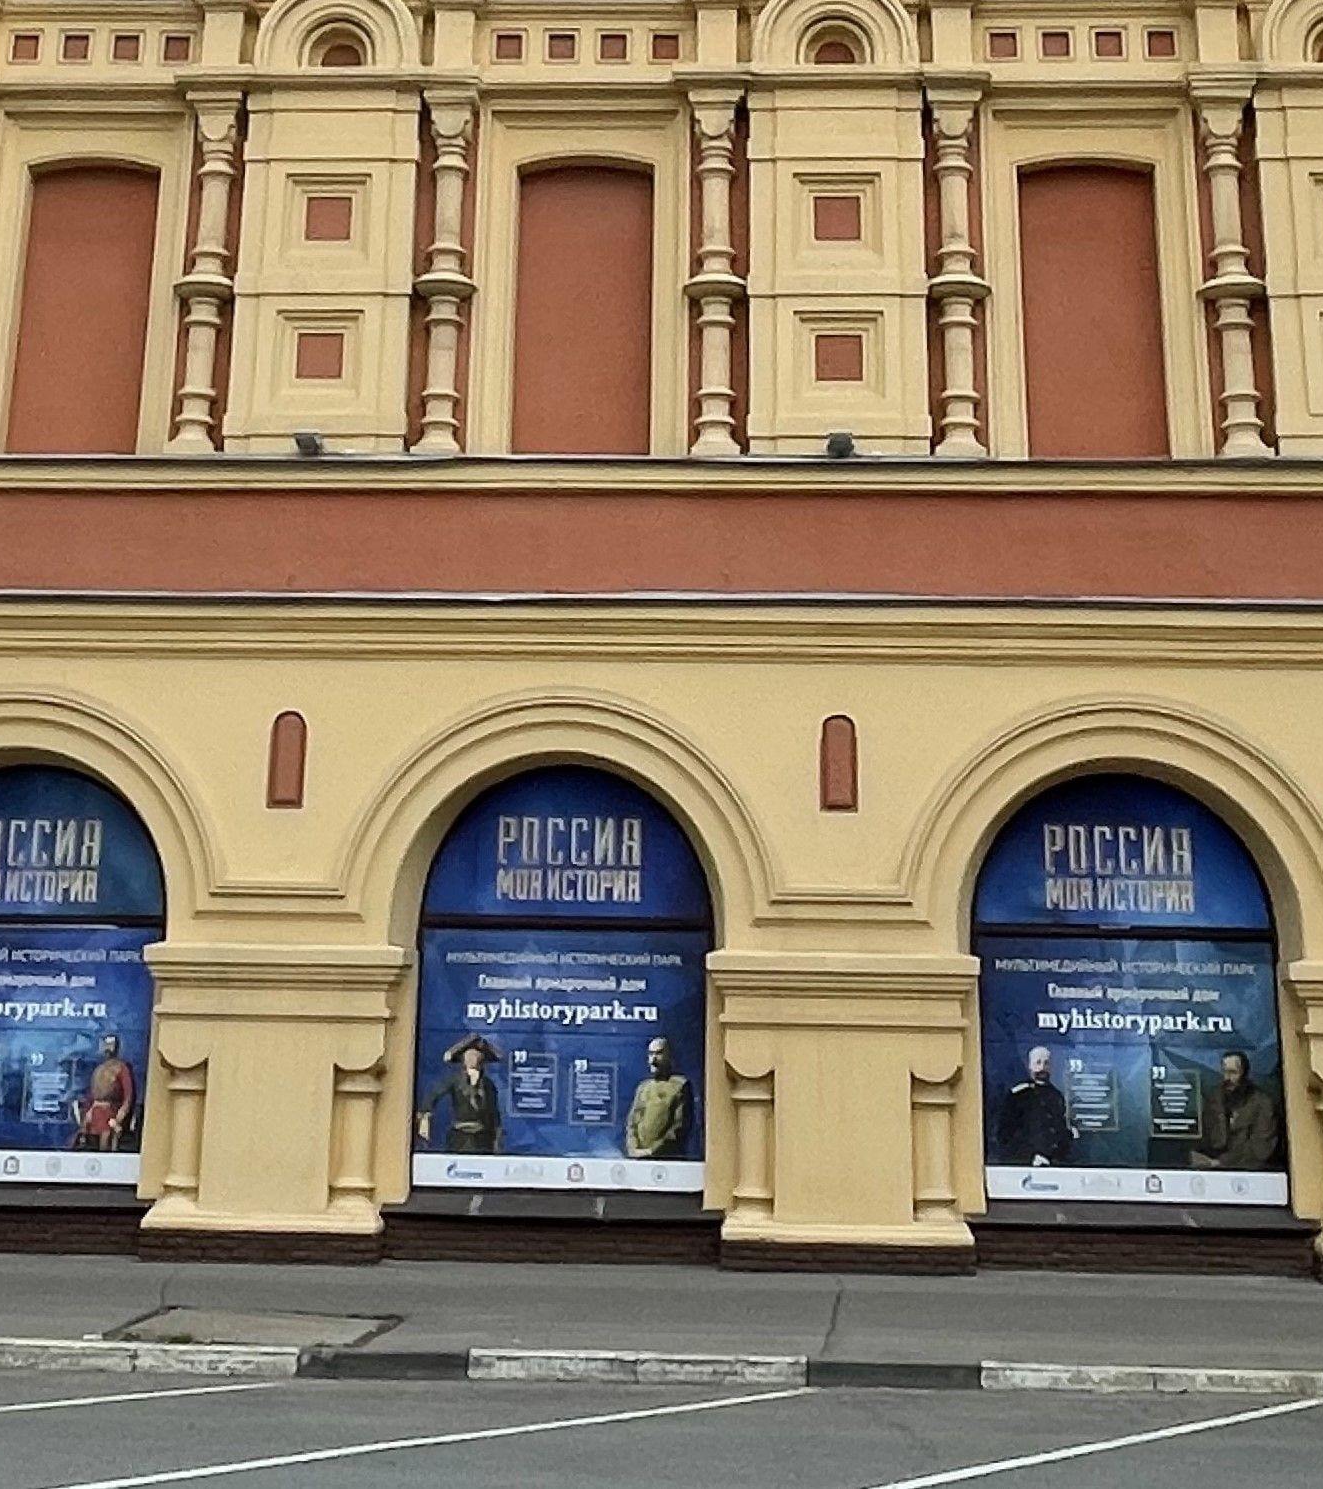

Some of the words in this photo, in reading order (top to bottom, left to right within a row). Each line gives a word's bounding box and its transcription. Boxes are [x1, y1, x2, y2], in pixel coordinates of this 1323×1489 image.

[498, 815, 643, 867] РОССИЯ
[1043, 823, 1192, 876] РОССИЯ
[4, 870, 98, 904] ИСТОРИЯ
[496, 868, 543, 901] МОЯ
[546, 868, 642, 903] ИСТОРИЯ
[1046, 877, 1093, 911] МОЯ
[1095, 878, 1194, 914] ИСТОРИЯ
[466, 997, 658, 1025] myhistorypark.ru
[1037, 1007, 1233, 1037] myhistorypark.ru
